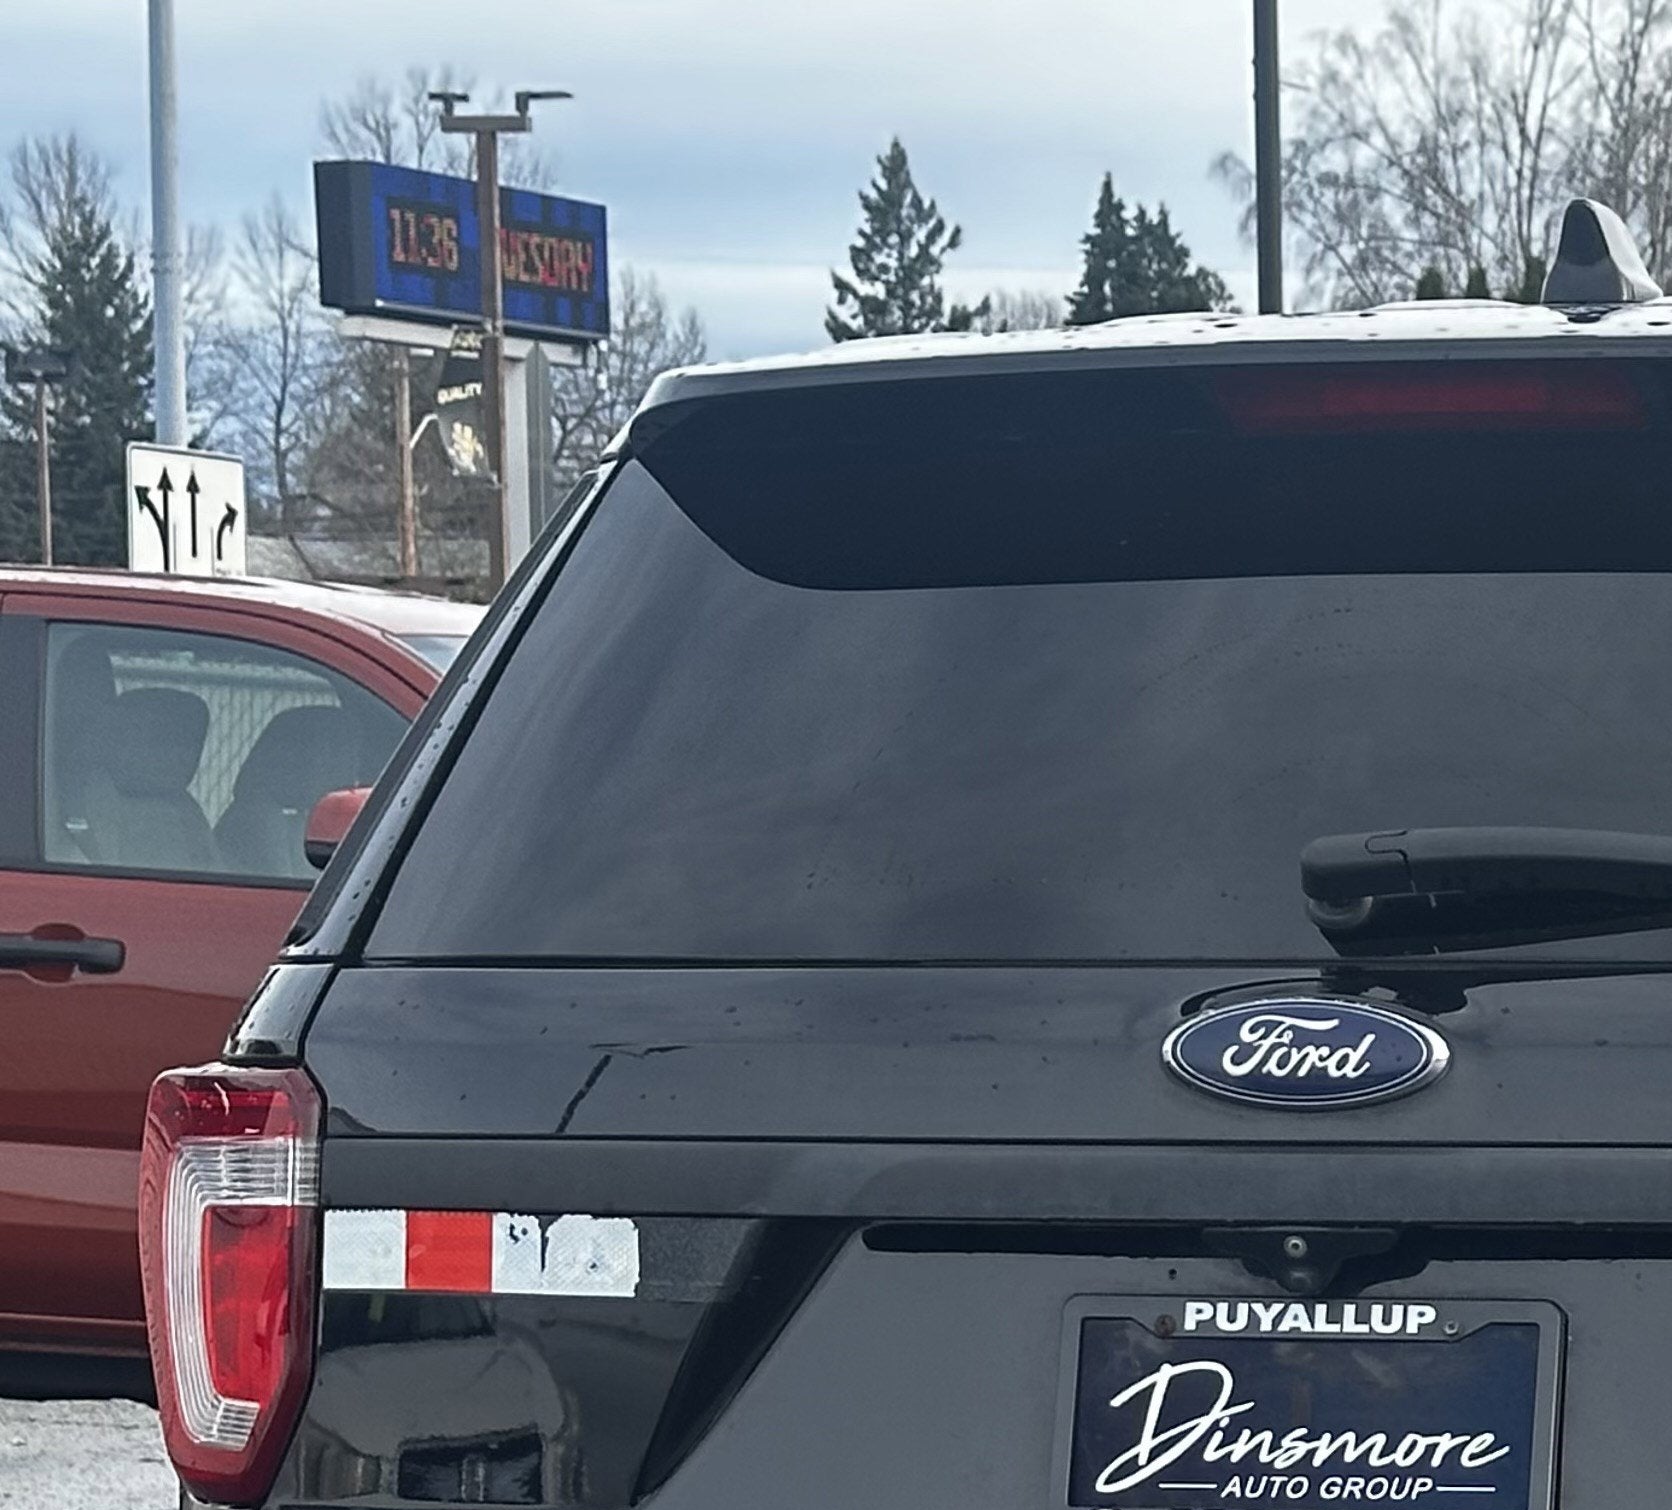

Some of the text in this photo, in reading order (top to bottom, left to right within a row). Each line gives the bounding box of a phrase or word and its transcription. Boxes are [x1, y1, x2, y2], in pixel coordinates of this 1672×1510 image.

[500, 227, 593, 292] UESDAY
[1222, 1014, 1376, 1078] Ford
[1183, 1301, 1438, 1335] PUYALLUP
[1095, 1360, 1511, 1494] Dinsmore
[1221, 1475, 1434, 1501] AUTO GROUP
